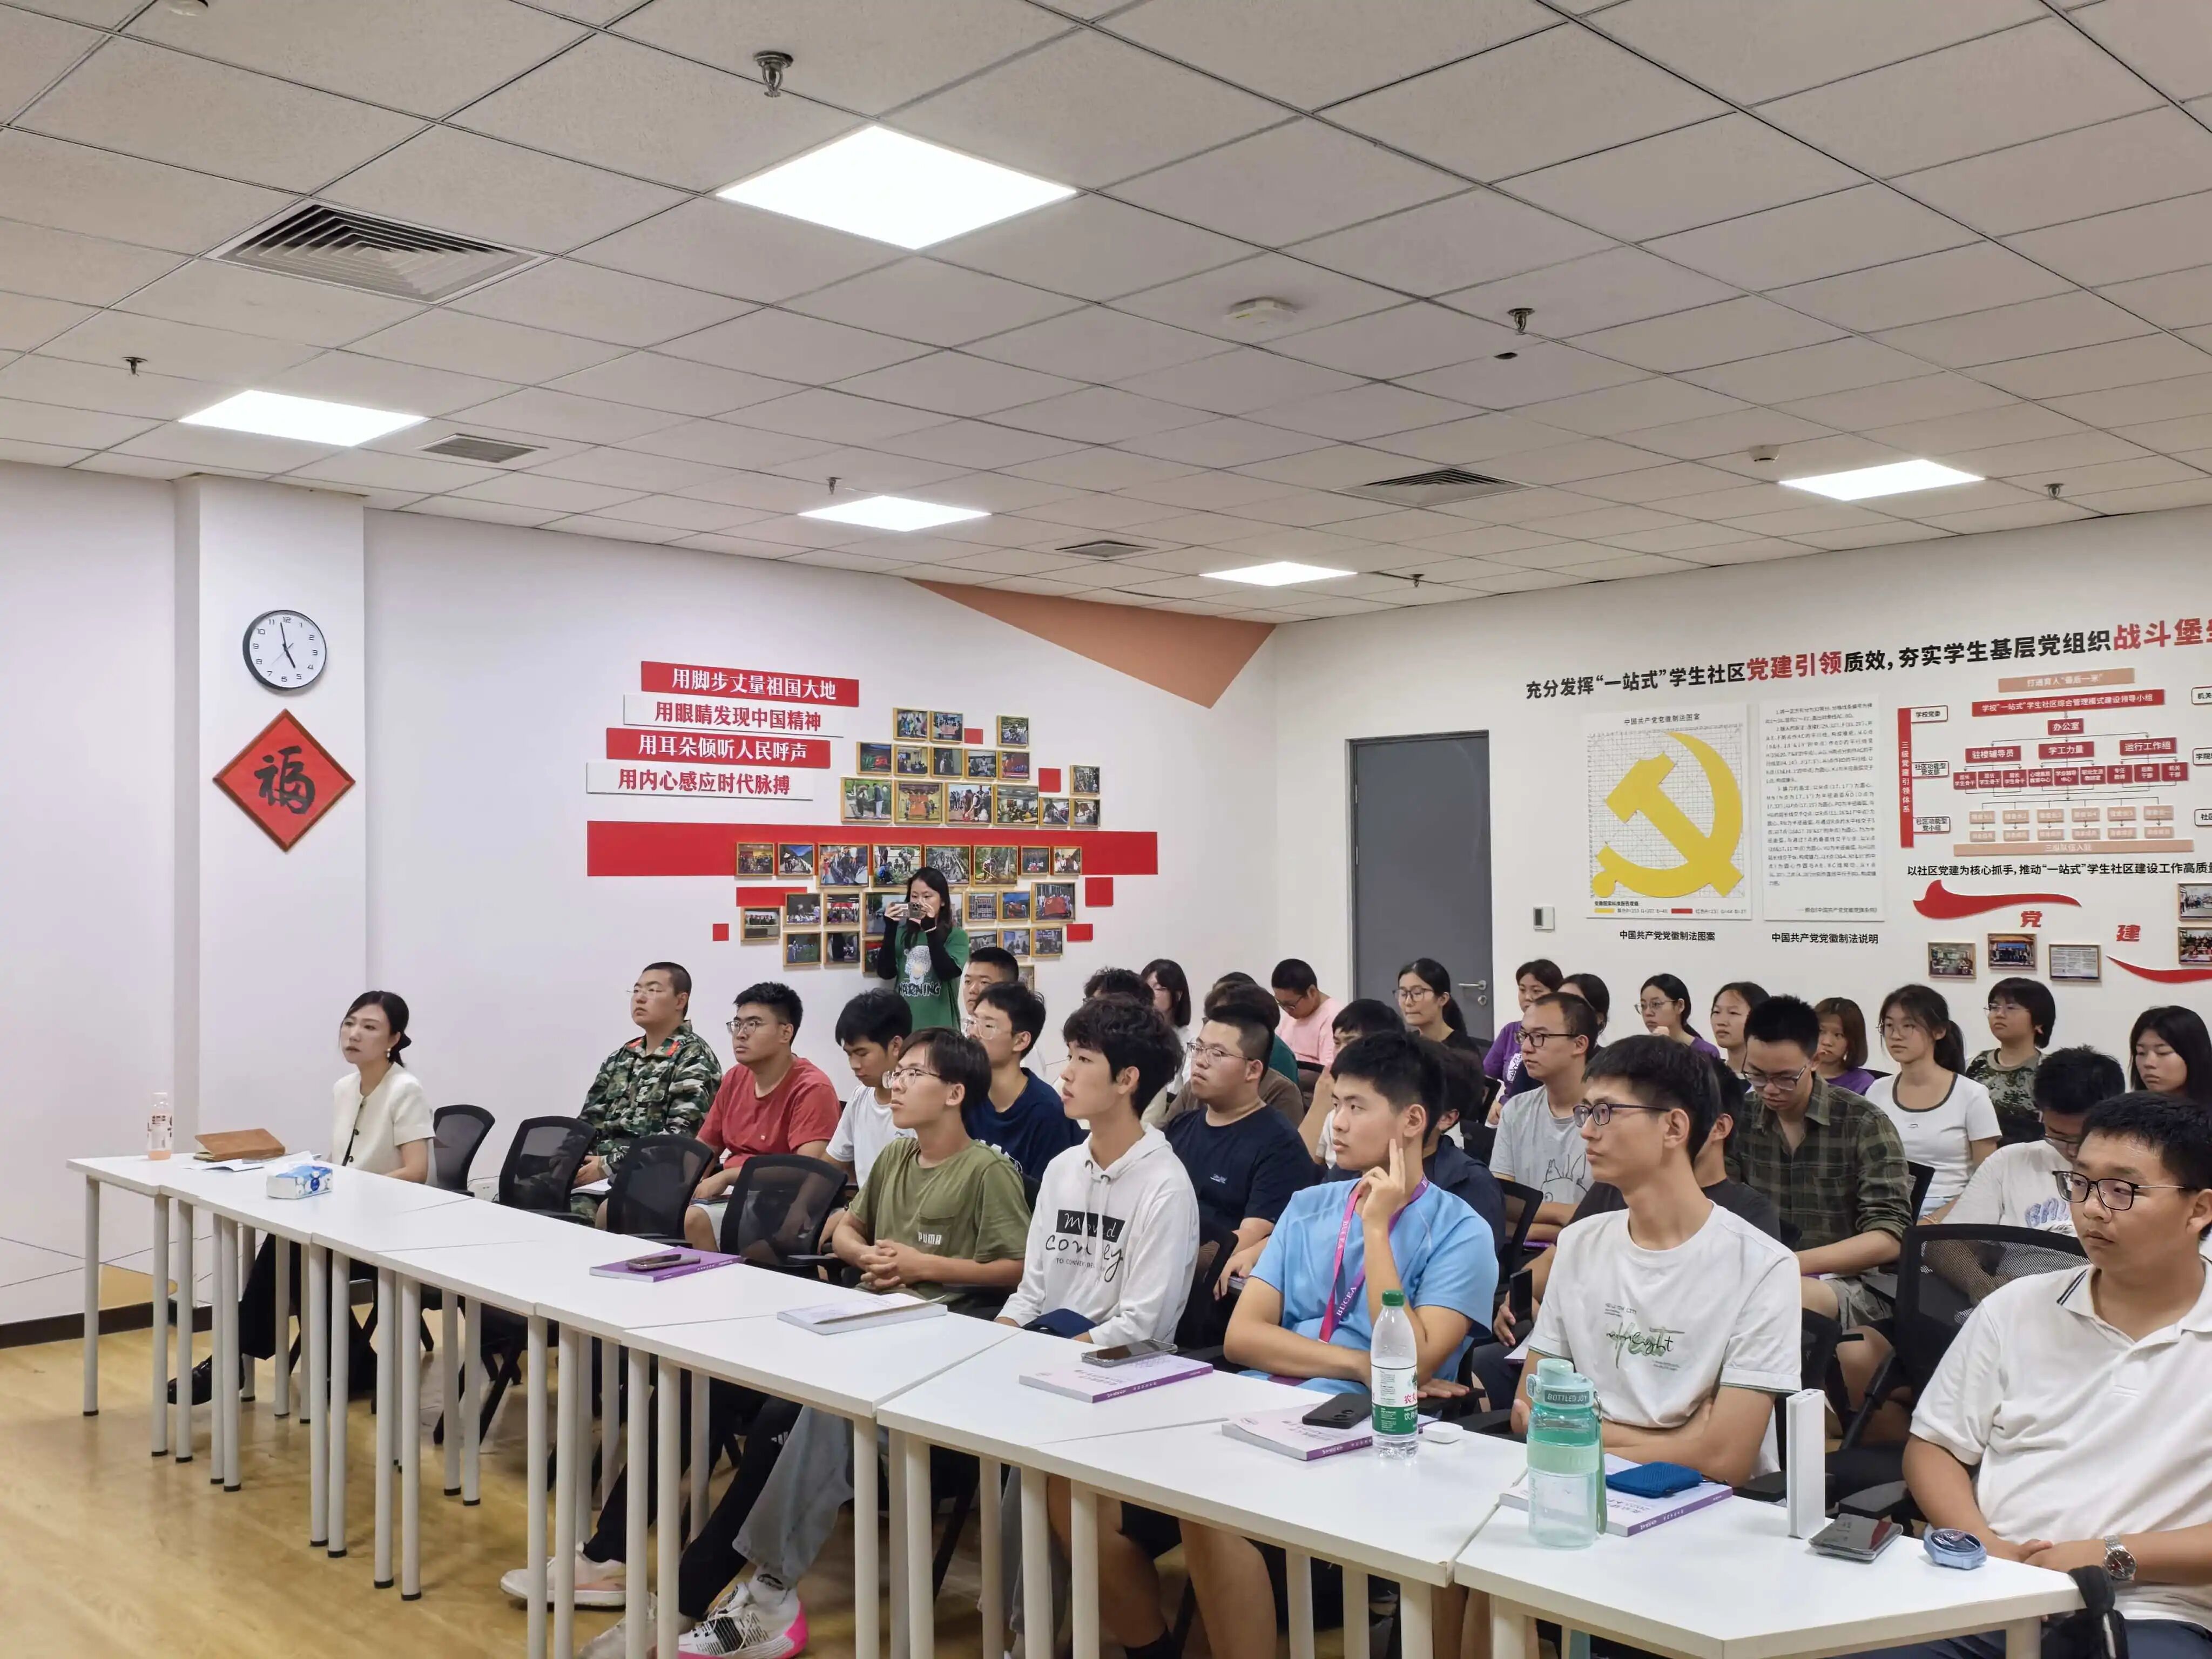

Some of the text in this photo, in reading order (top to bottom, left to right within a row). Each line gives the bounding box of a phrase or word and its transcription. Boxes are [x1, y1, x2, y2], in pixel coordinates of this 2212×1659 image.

[1526, 618, 2212, 699] 充分发挥“一站式”学生社区党建引领质效，夯实学生基层党组织战斗堡
[672, 668, 837, 700] 用脚步丈量祖国大地
[655, 702, 821, 731] 用眼睛发现中国精神
[2053, 722, 2080, 732] 办公室
[638, 734, 807, 762] 用耳朵倾听人民呼声
[2048, 745, 2083, 755] 学工力量
[2125, 741, 2171, 751] 运行工作组
[254, 745, 315, 814] 福
[619, 768, 790, 795] 用内心感应时代脉搏
[2020, 911, 2043, 928] 党
[1620, 930, 1715, 941] 中国共产党党徽制法图案
[1772, 933, 1878, 945] 中国共产党党徽制法说明
[2116, 924, 2141, 942] 建
[918, 1231, 942, 1245] PUMA
[1336, 1286, 1357, 1316] BUCEA
[1547, 1393, 1576, 1402] BOTTLED
